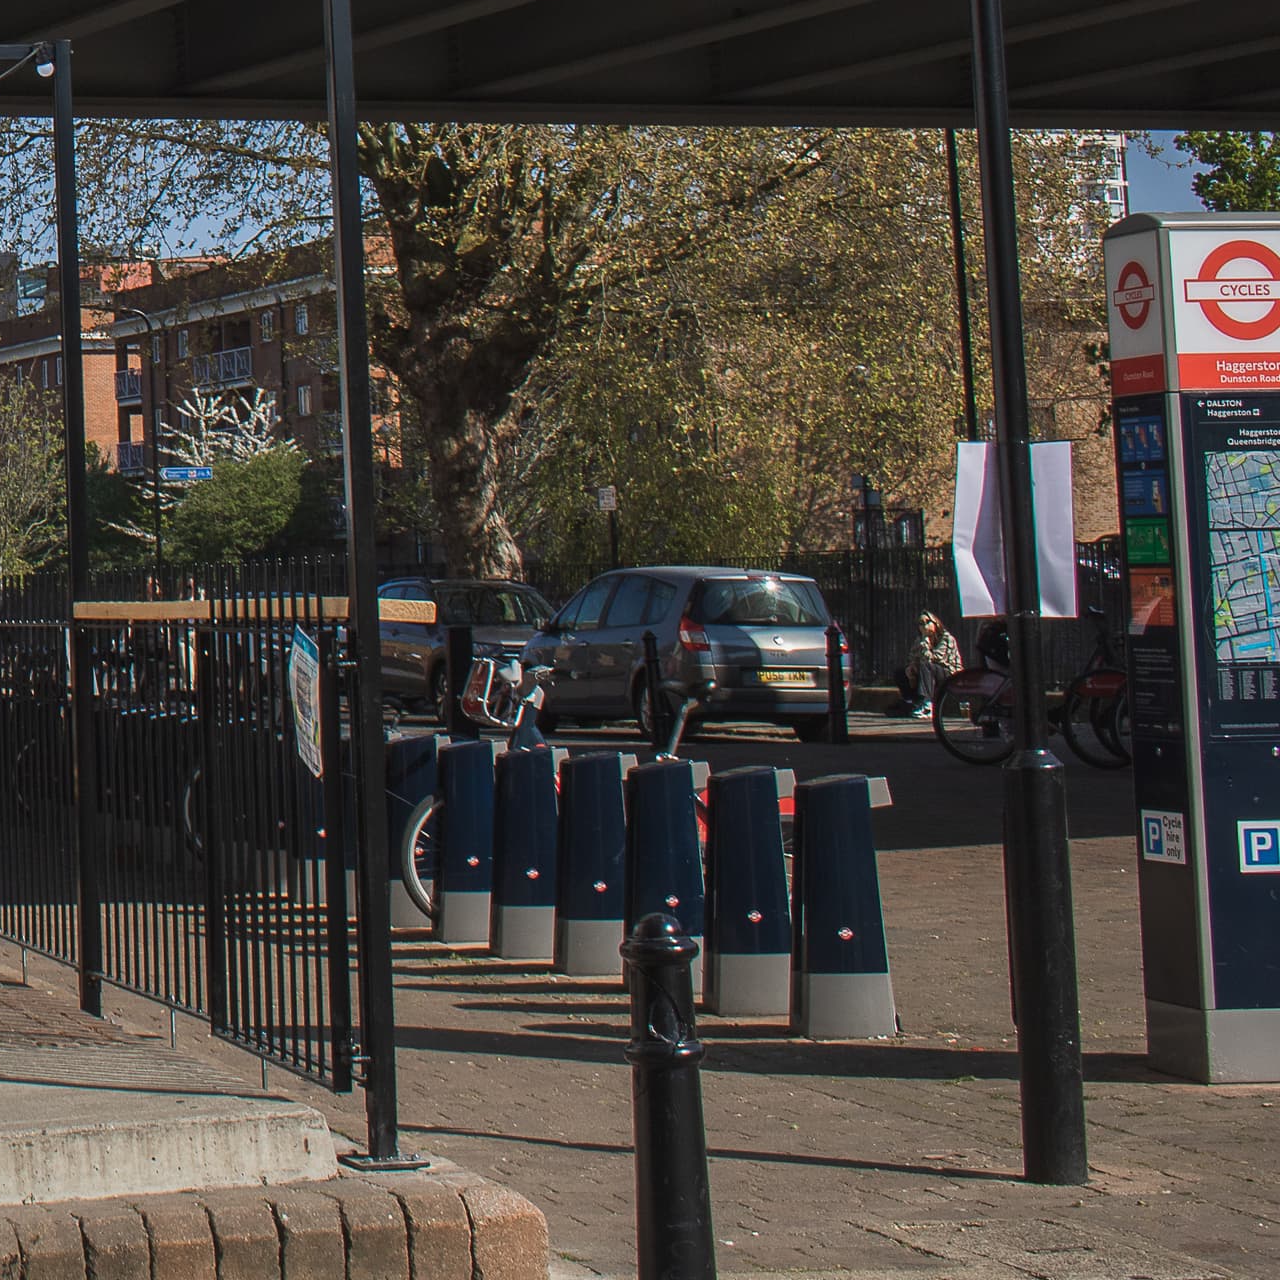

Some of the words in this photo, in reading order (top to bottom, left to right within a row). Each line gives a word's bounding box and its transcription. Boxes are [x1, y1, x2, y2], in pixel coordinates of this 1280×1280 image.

[1220, 283, 1271, 297] CYCLES
[1220, 374, 1258, 383] Dunston
[1259, 374, 1280, 383] Road
[1206, 400, 1243, 408] DALSTON
[1207, 409, 1252, 418] Haggerston
[1239, 428, 1280, 438] Haggersto
[1162, 815, 1182, 830] Cycle
[1149, 822, 1160, 851] P
[1166, 830, 1180, 843] hire
[1166, 846, 1181, 860] only
[1250, 831, 1272, 862] P
